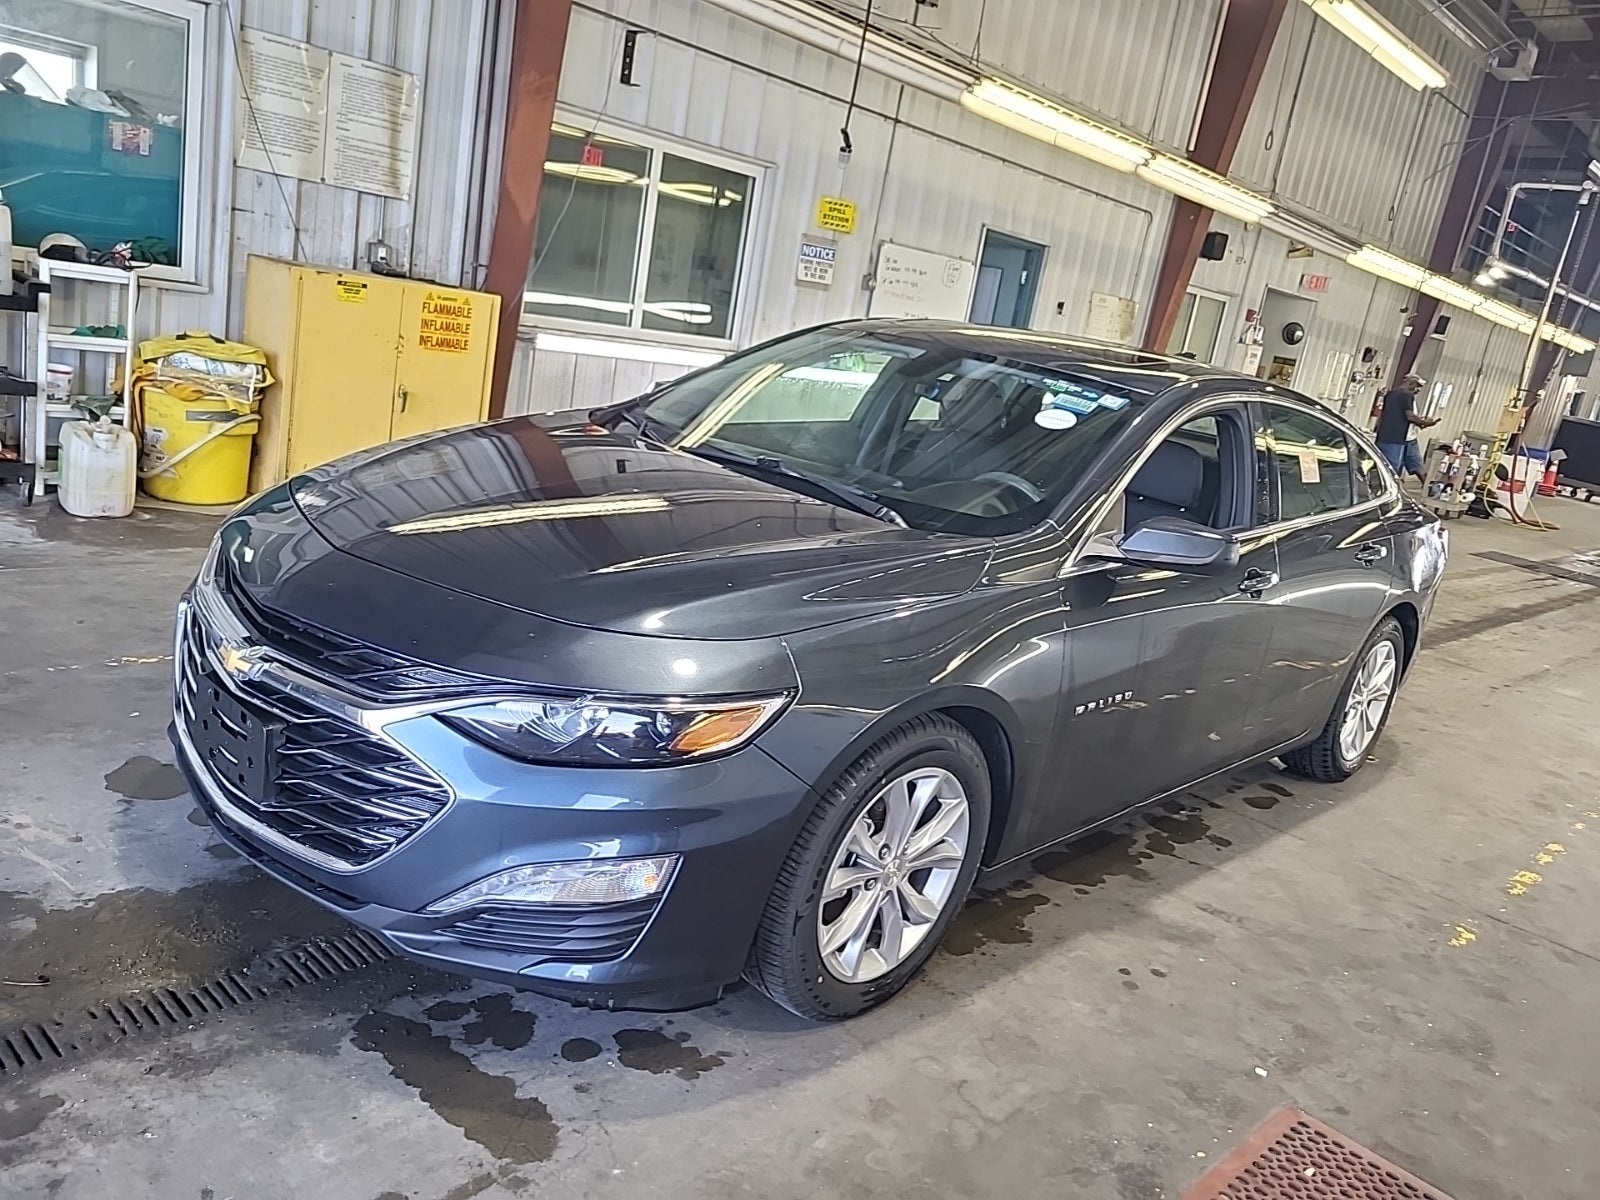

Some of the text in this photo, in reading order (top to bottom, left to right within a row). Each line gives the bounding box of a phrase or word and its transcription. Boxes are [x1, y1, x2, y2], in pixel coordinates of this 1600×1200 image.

[822, 213, 850, 223] STATION
[828, 206, 846, 215] SPILL
[802, 244, 835, 260] NOTICE
[422, 301, 473, 319] FLAMMABLE
[420, 318, 471, 335] INFLAMABLE
[418, 334, 469, 351] INFLAMMABLE
